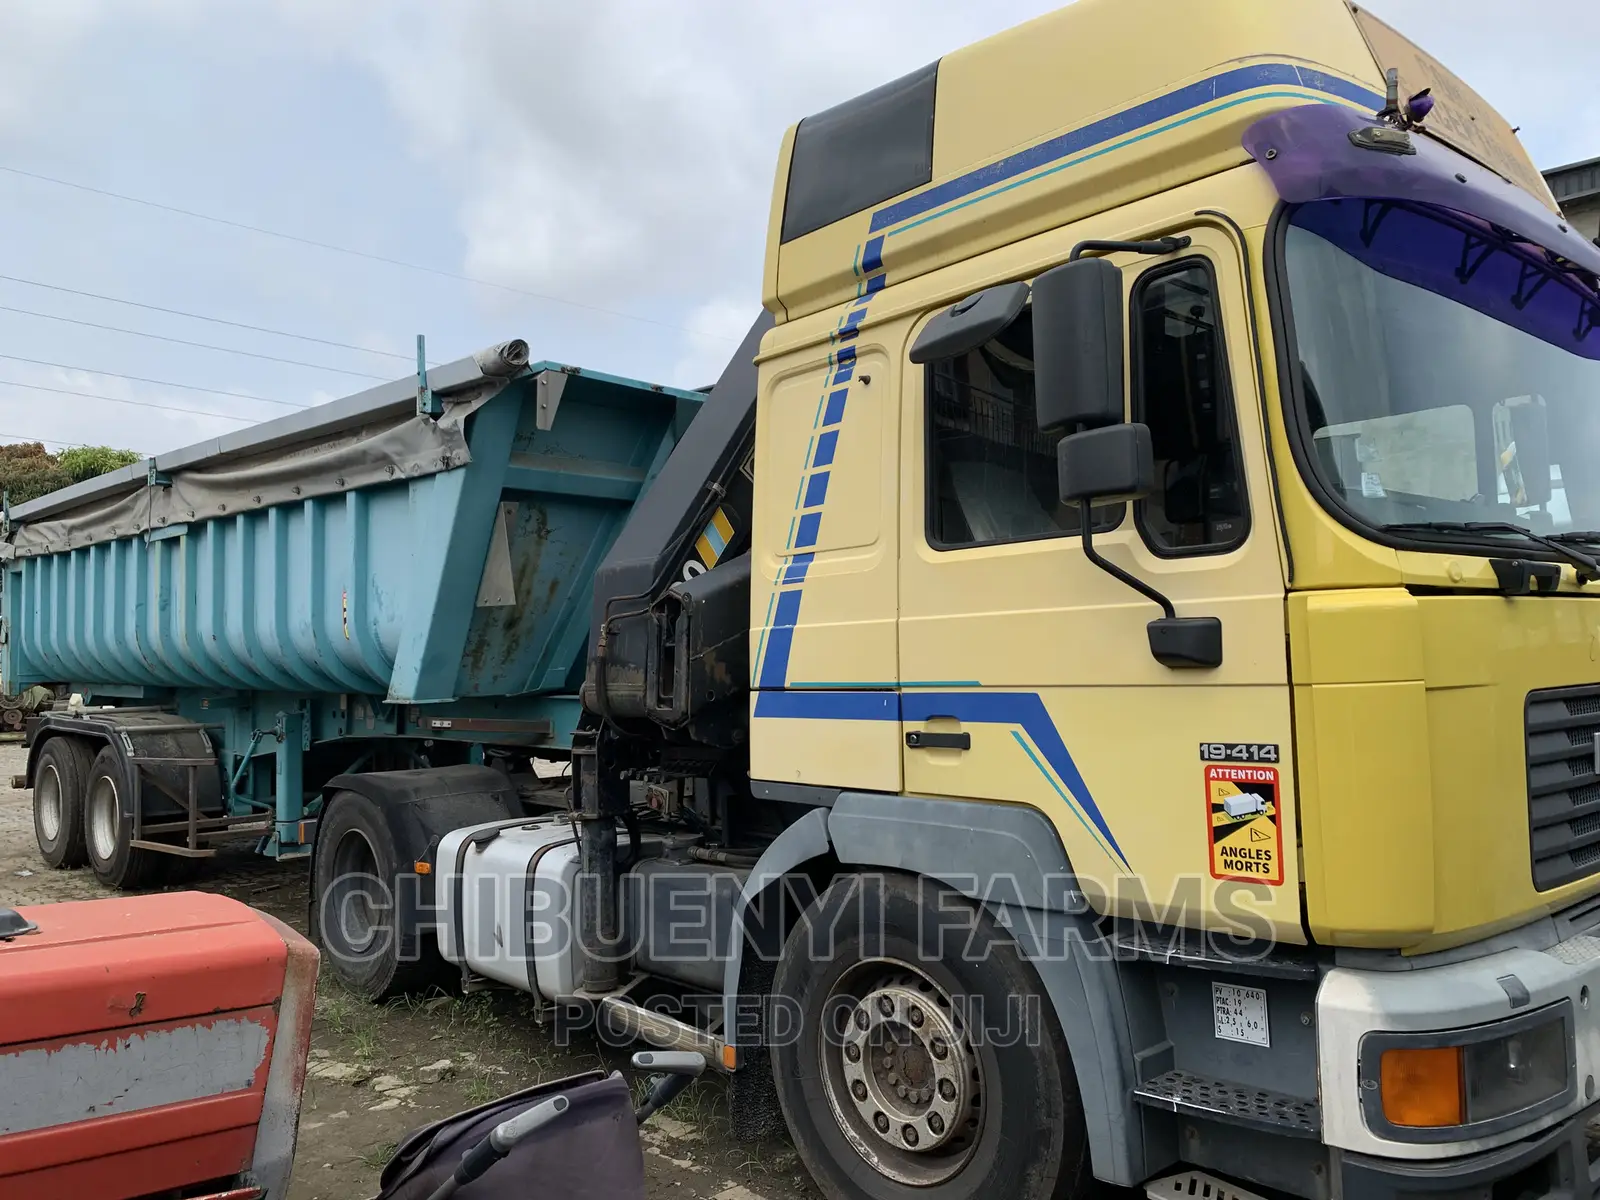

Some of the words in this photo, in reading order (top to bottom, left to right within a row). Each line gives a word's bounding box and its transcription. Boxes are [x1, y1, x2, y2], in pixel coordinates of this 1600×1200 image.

[1209, 768, 1274, 780] ATTENTION
[1220, 846, 1272, 860] ANGLES
[1223, 859, 1270, 874] MORTS
